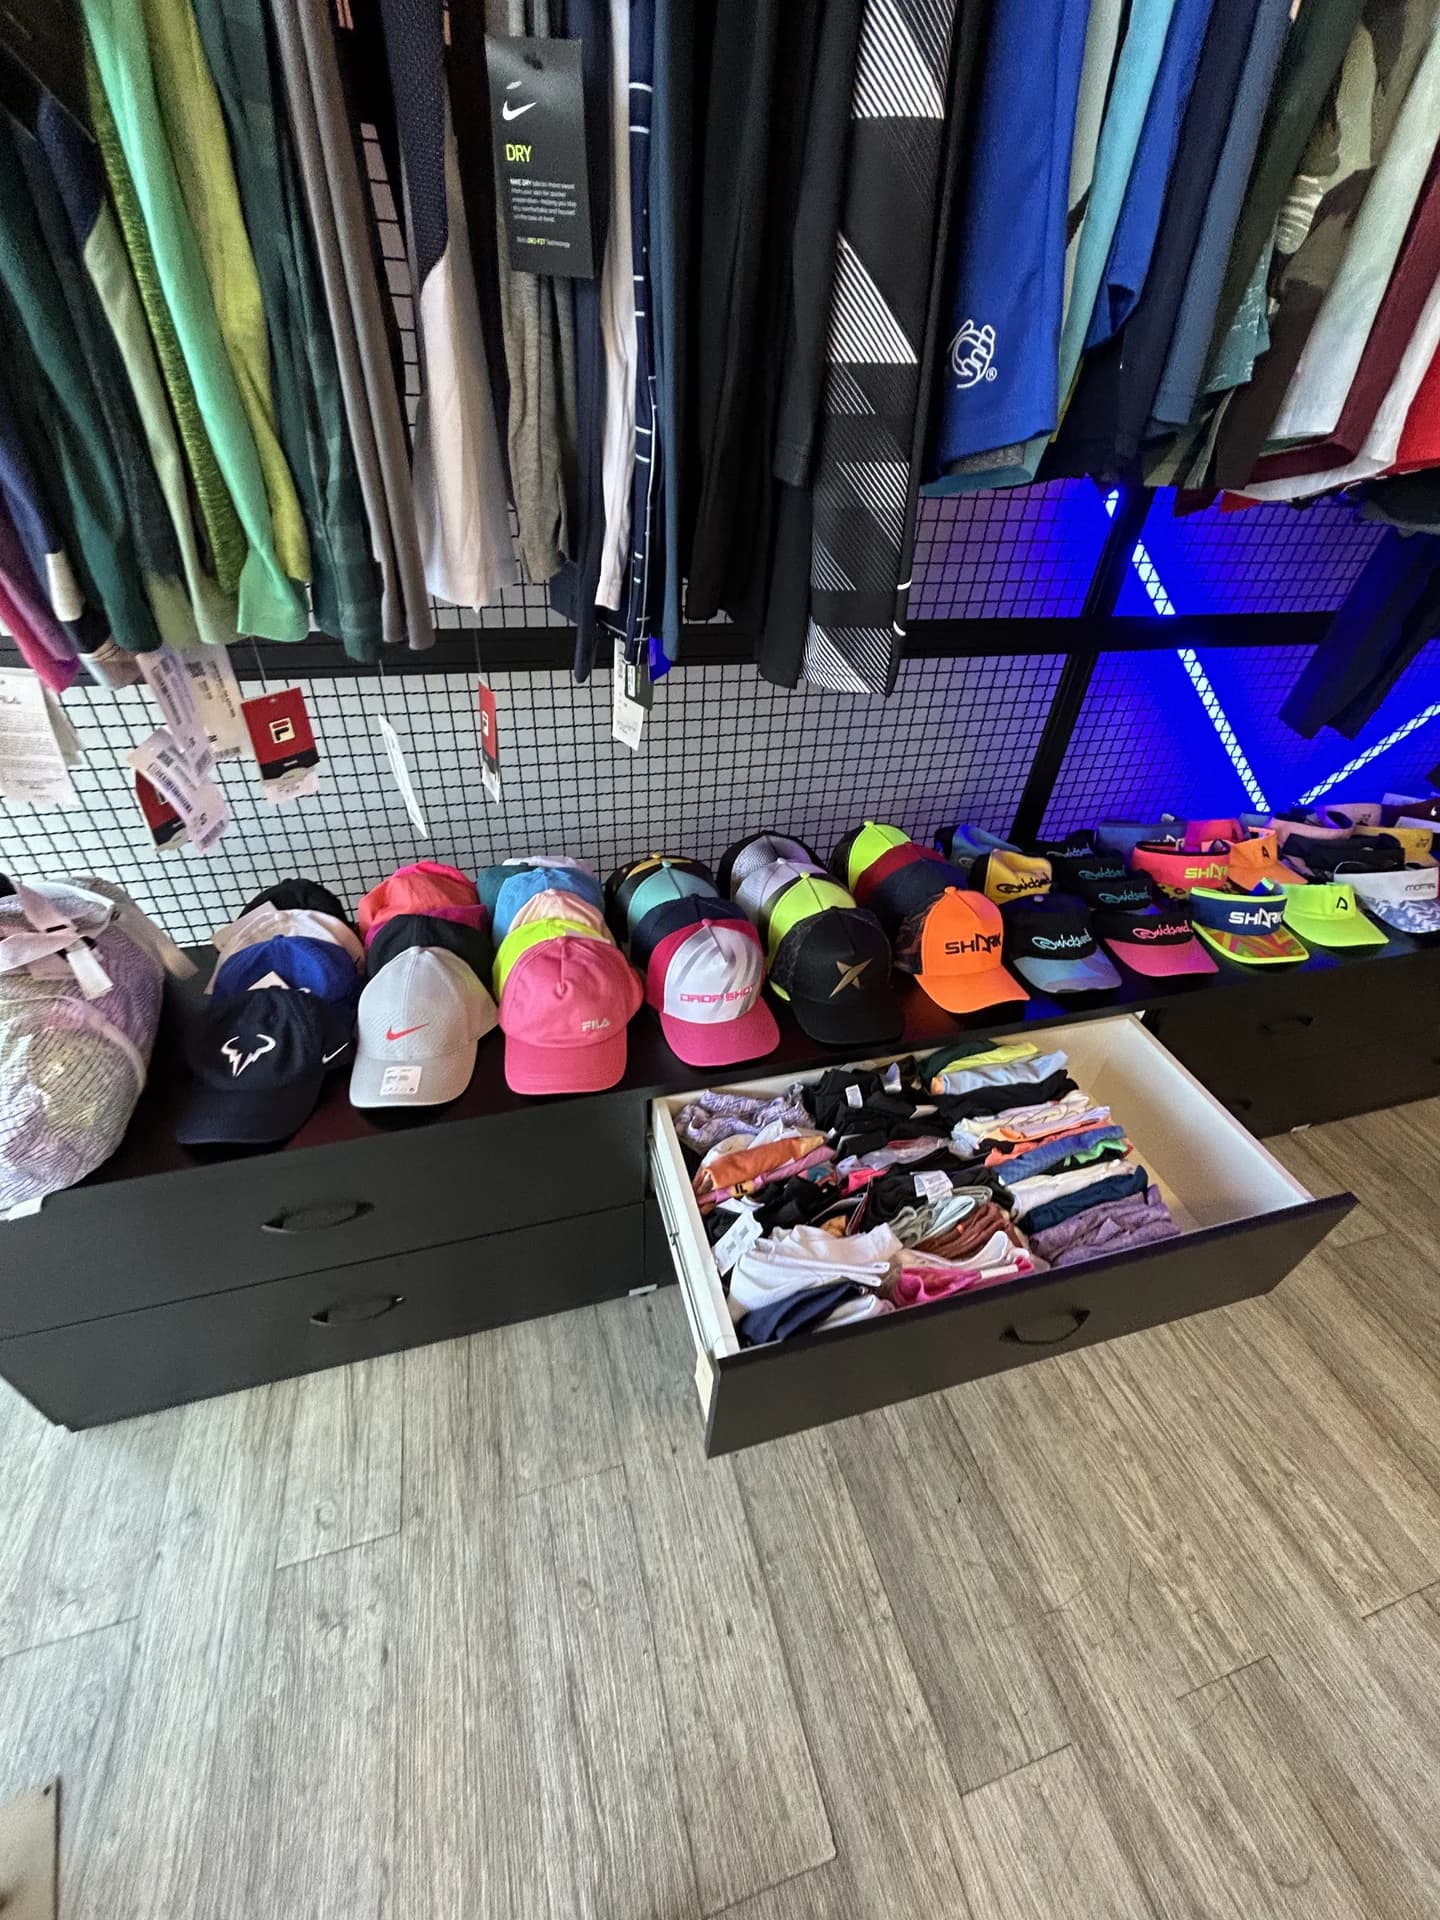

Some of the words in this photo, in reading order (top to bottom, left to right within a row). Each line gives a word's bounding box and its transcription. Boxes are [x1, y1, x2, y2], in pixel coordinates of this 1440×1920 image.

[505, 143, 533, 163] DRY
[1183, 862, 1229, 881] SHAR
[1228, 907, 1284, 929] SHARK
[944, 932, 1002, 955] SHARK
[679, 993, 722, 1003] DROP
[581, 1016, 611, 1033] FILA
